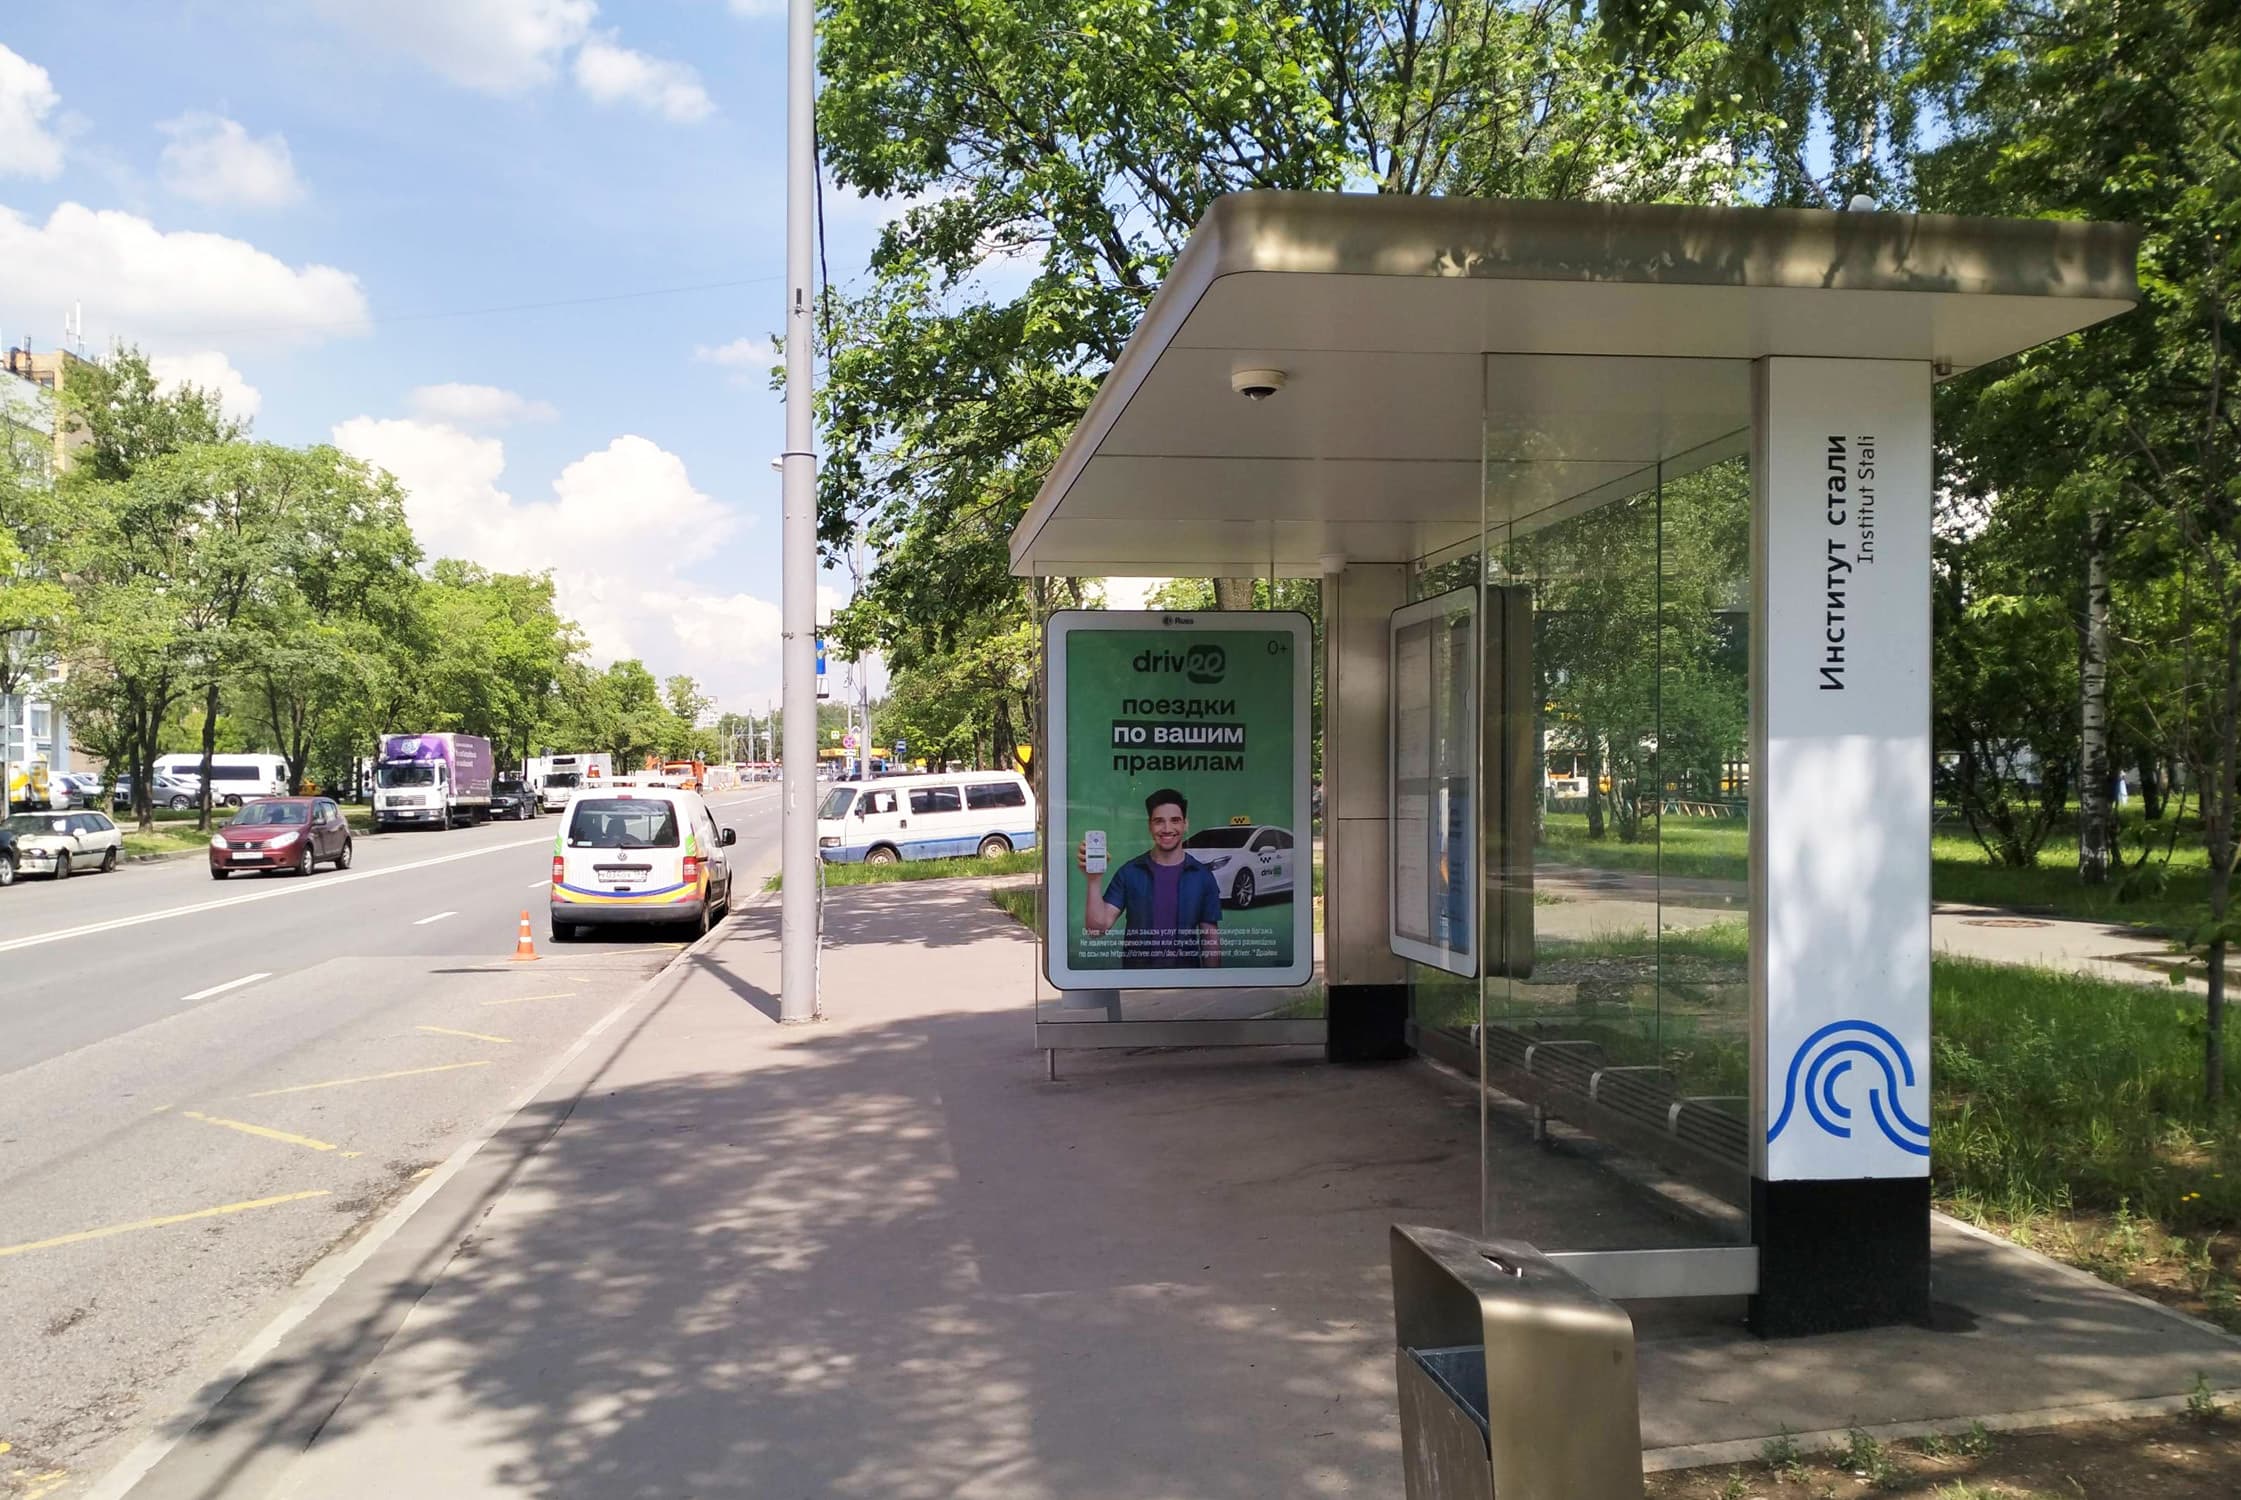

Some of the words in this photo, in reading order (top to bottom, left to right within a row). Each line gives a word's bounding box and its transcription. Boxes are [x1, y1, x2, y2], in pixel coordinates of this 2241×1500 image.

[1857, 435, 1875, 480] Stali
[1827, 435, 1847, 526] стали
[1857, 485, 1875, 565] Institut
[1819, 538, 1852, 690] Институт
[1267, 640, 1289, 656] 0+
[1122, 698, 1235, 718] поездки
[1113, 726, 1146, 743] по
[1154, 726, 1244, 744] вашим
[1113, 754, 1244, 776] правилам
